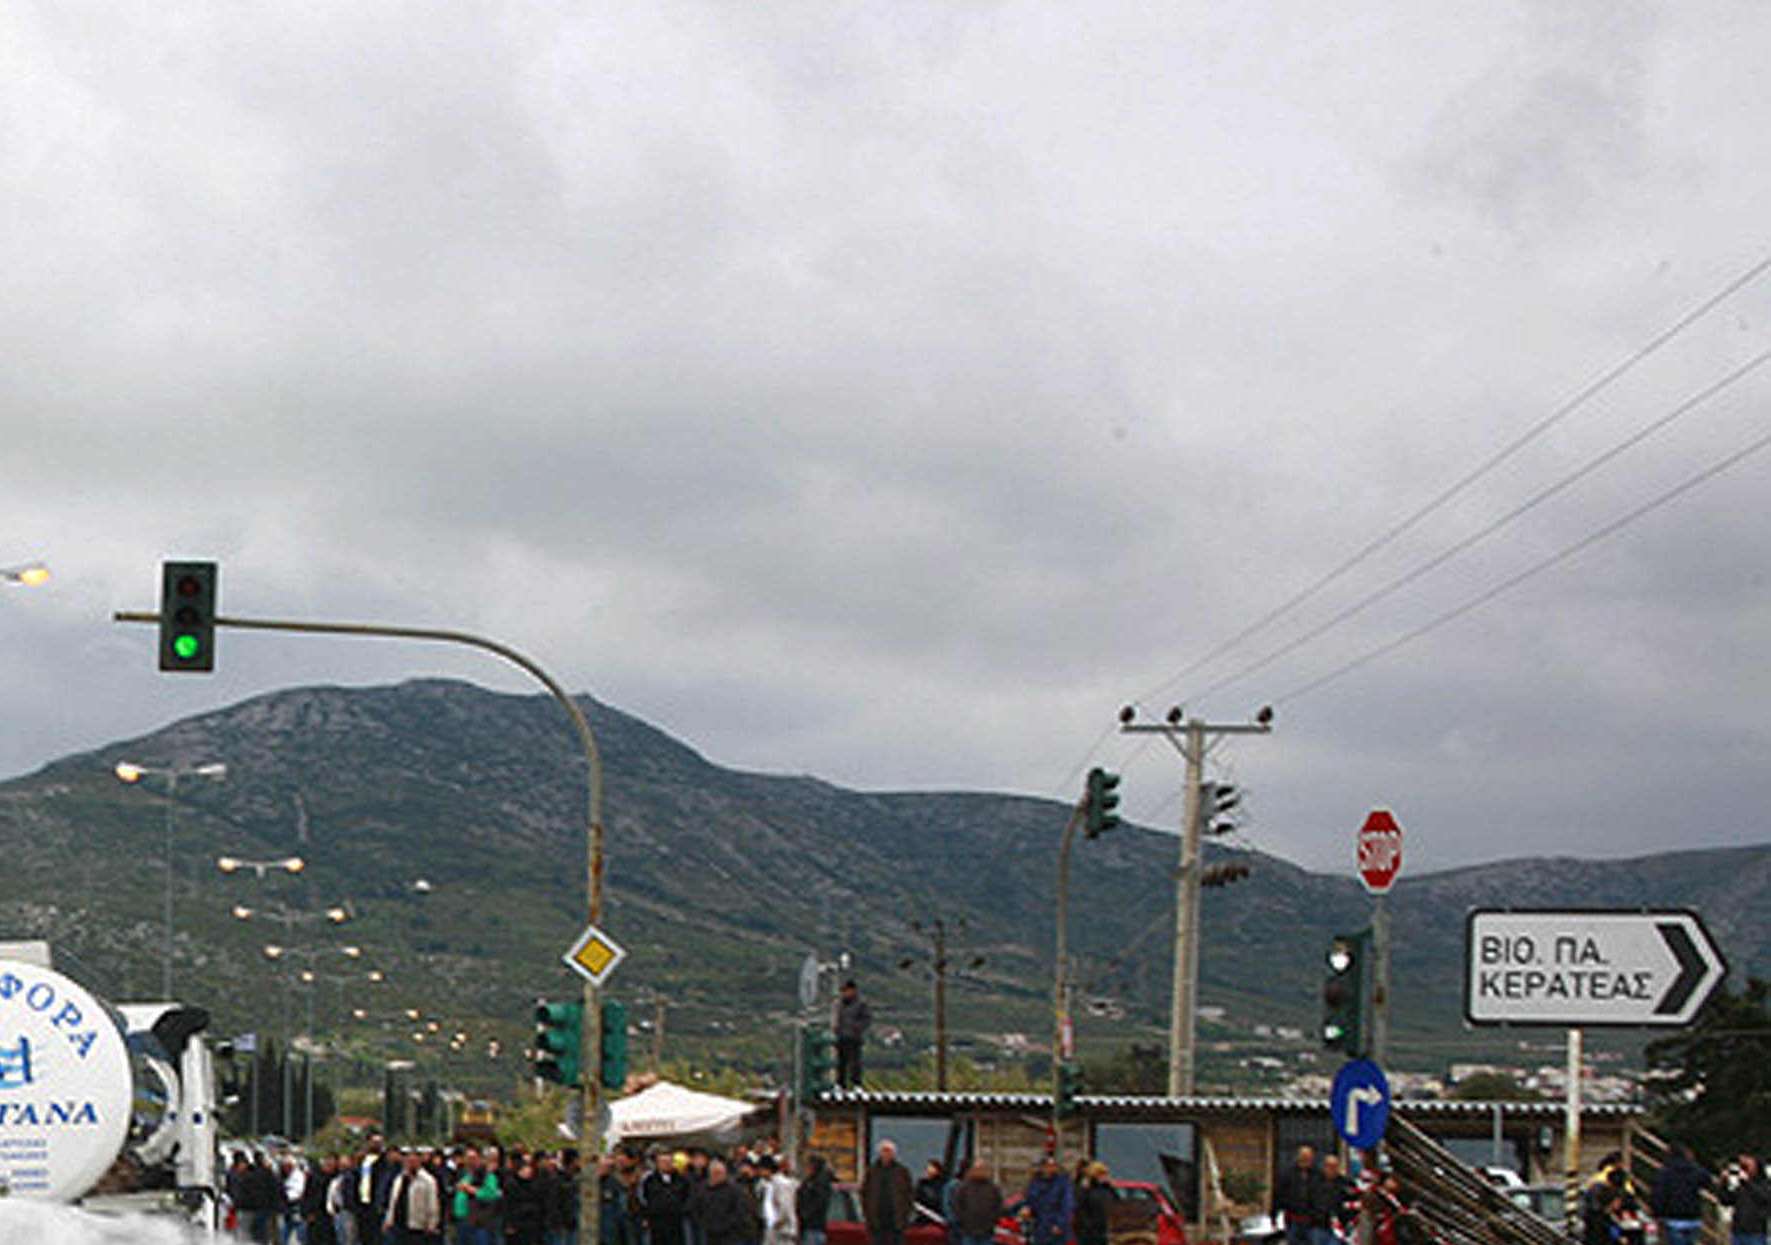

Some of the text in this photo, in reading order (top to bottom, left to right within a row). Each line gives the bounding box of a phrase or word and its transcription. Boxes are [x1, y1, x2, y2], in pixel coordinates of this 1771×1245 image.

[1359, 831, 1401, 872] STOP
[1481, 935, 1611, 965] ΒΙΟ. ΠΑ.
[1480, 970, 1653, 999] ΚΕΡΑΤΕΑΣ
